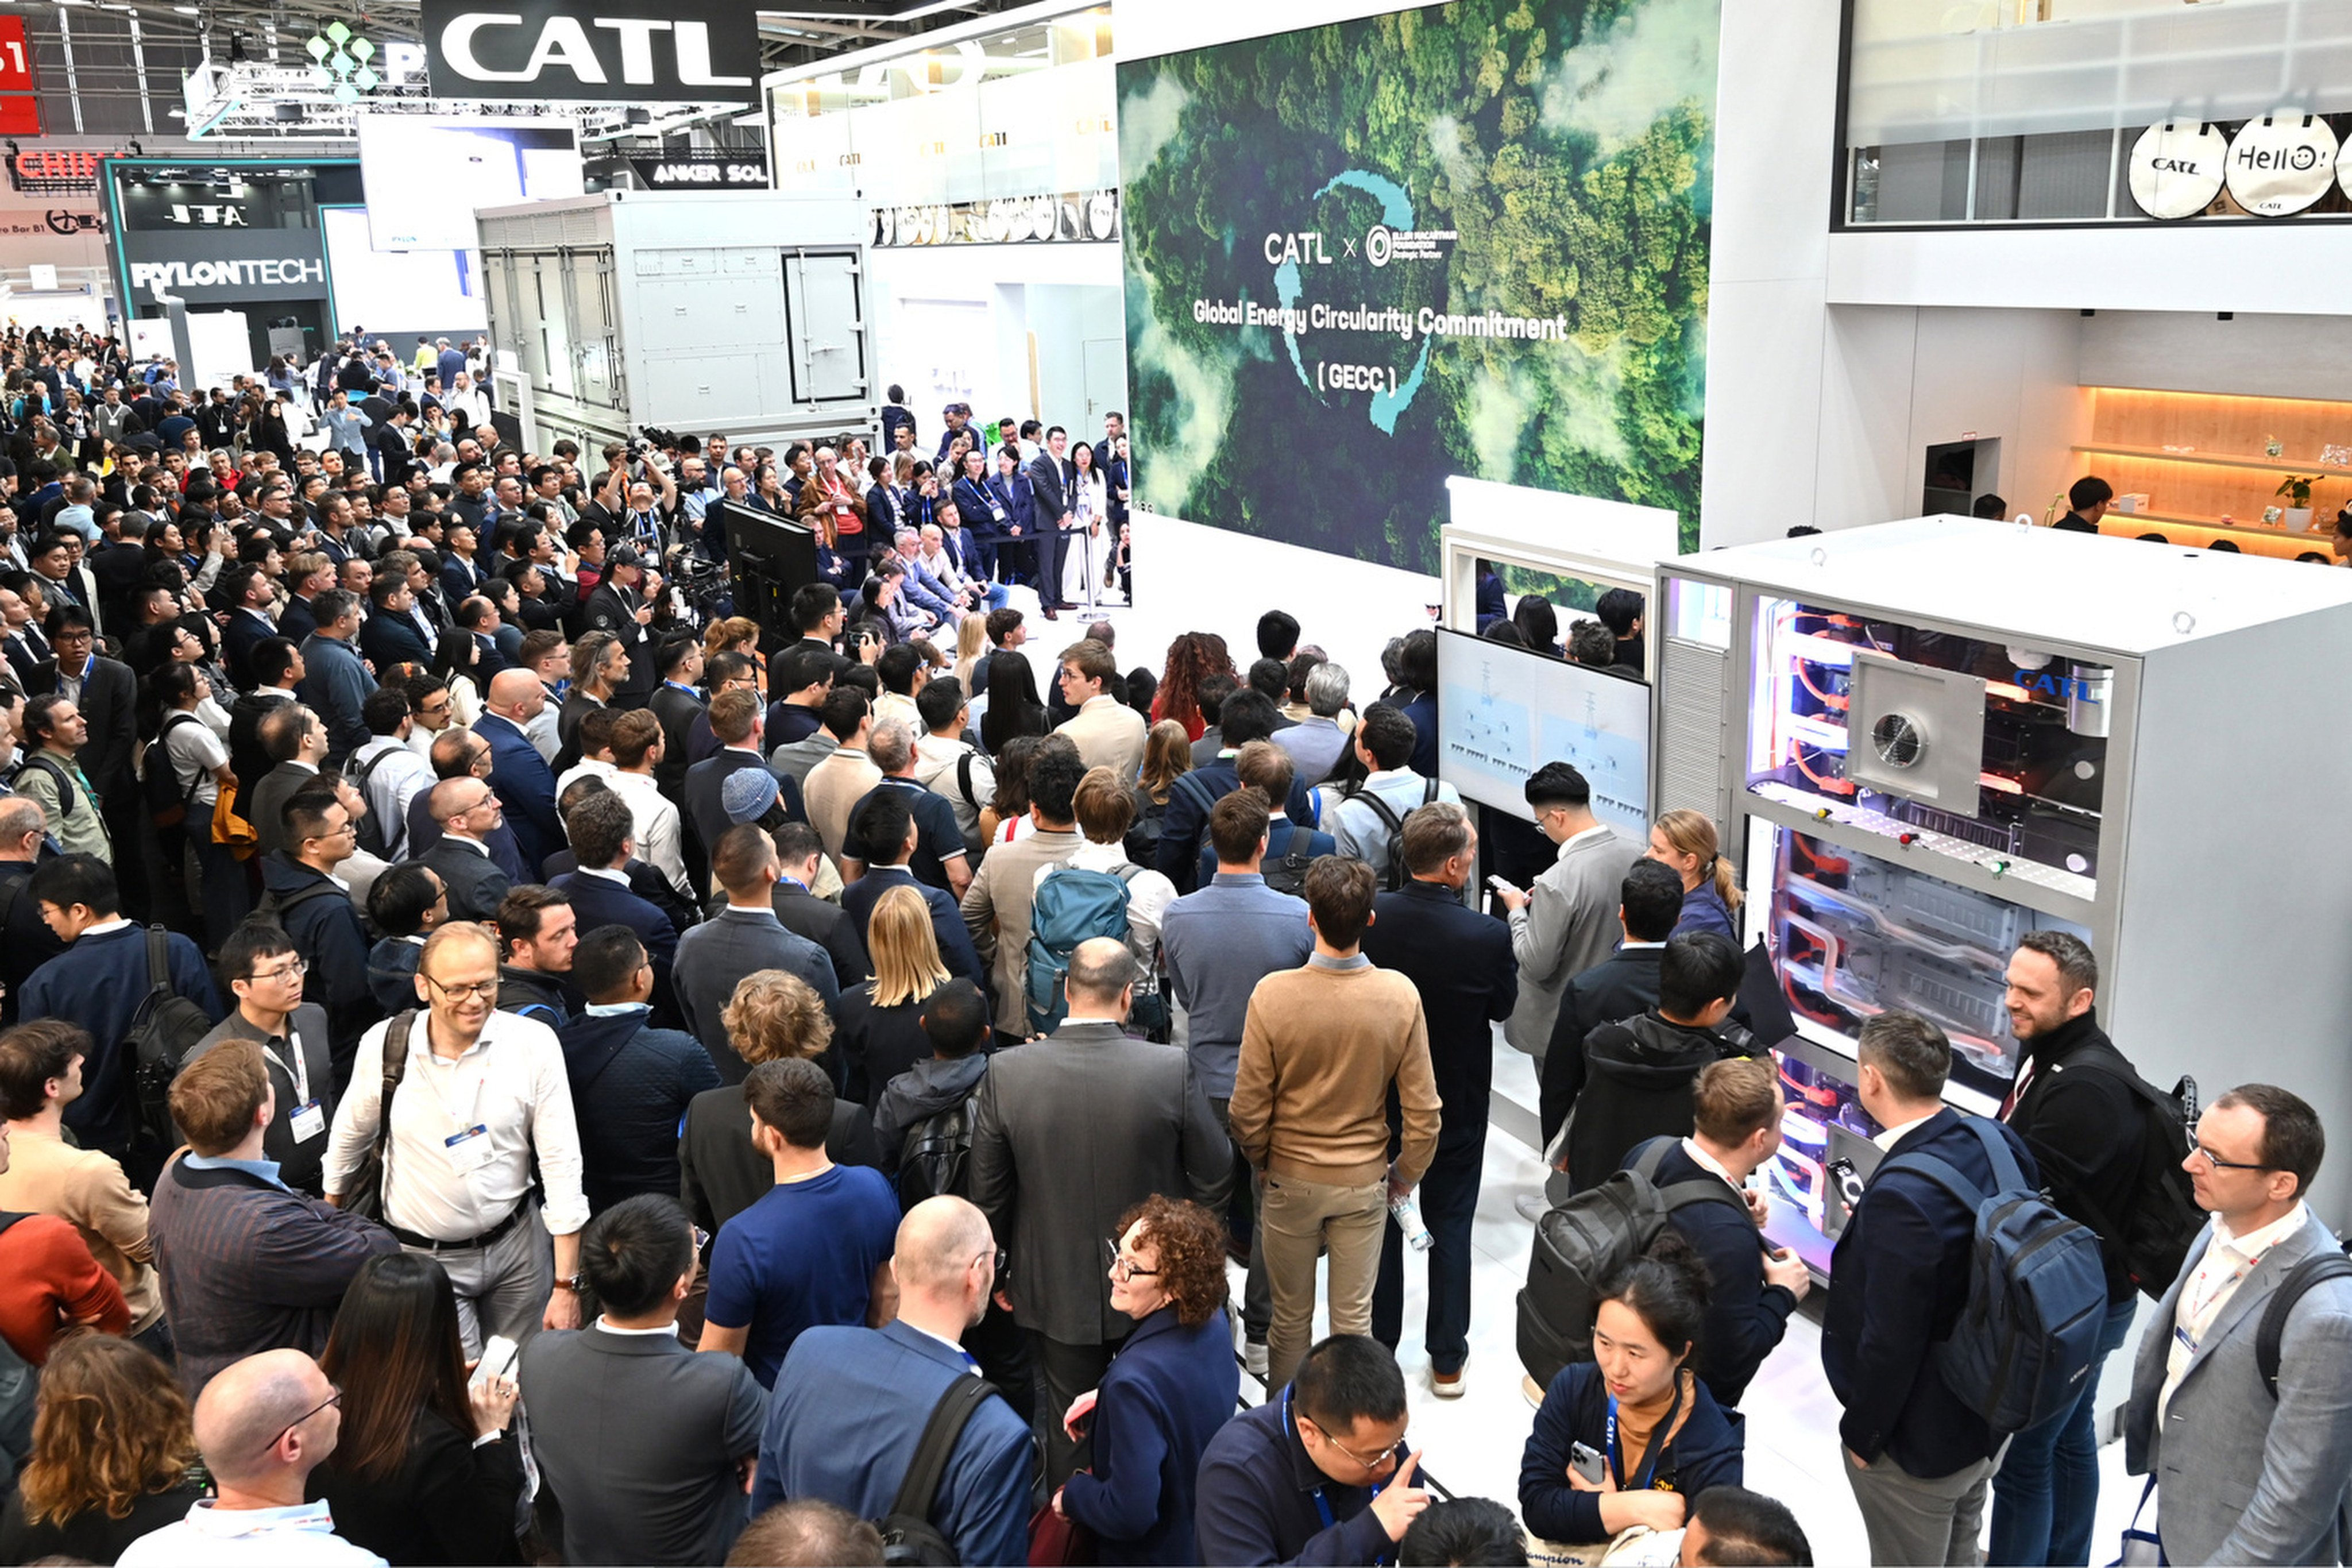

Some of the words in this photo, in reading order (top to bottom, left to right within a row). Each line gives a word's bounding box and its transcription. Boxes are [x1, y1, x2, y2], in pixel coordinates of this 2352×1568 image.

[0, 42, 25, 73] 1
[441, 13, 752, 86] CATL
[654, 164, 721, 183] ANKER
[2152, 157, 2200, 175] CATL
[12, 225, 29, 233] Bar
[1265, 232, 1333, 265] CATL
[130, 258, 324, 287] PYLONTECH
[1194, 299, 1242, 325] Global
[1246, 302, 1307, 335] Energy
[1311, 303, 1413, 341] Circularity
[1418, 306, 1567, 341] Commitment
[2014, 669, 2099, 705] CATL
[1606, 1415, 1615, 1445] CATL
[1527, 1552, 1584, 1567] ampion
